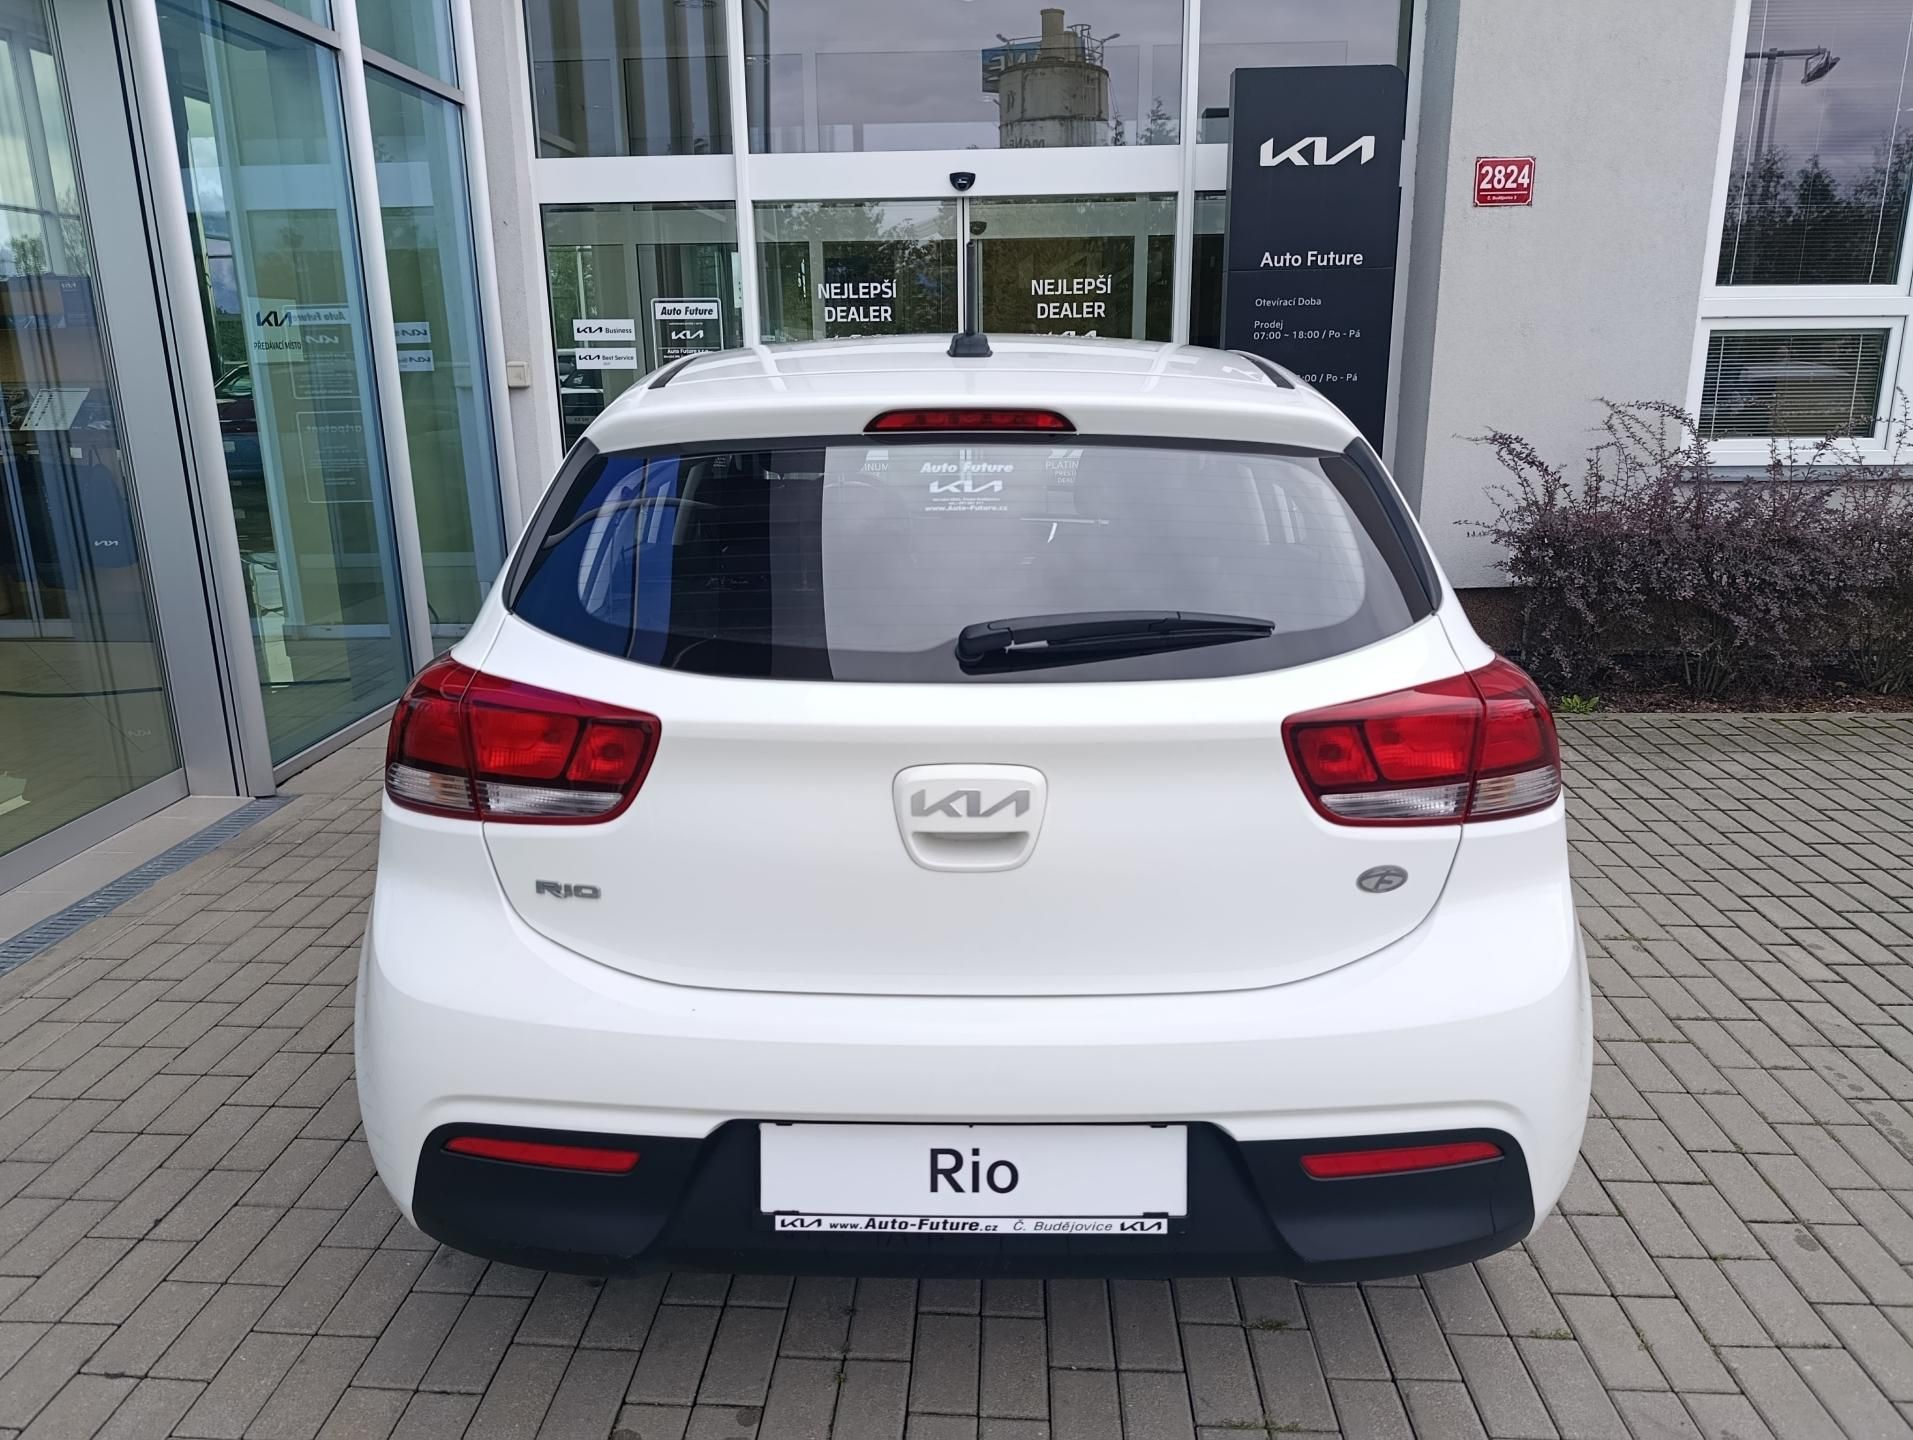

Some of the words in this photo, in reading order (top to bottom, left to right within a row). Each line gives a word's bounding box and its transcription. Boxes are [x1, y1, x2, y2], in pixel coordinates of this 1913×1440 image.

[1259, 135, 1376, 167] KIA
[1480, 165, 1530, 189] 2824
[1260, 252, 1302, 267] Auto
[1307, 251, 1364, 266] Future
[817, 278, 897, 300] NEJLEPŠÍ
[1031, 274, 1112, 296] NEJLEPŠÍ
[1255, 297, 1296, 307] Otevírací
[1298, 297, 1322, 306] Doba
[661, 306, 681, 316] Auto
[685, 306, 714, 316] Future
[824, 306, 892, 323] DEALER
[1037, 302, 1106, 319] DEALER
[256, 311, 293, 327] KIA
[1254, 320, 1284, 331] Prodej
[671, 329, 704, 340] KIA
[1253, 331, 1281, 340] 07:00
[1293, 330, 1320, 339] 18:00
[1328, 331, 1341, 339] Po
[1349, 329, 1361, 338] Pá
[1326, 374, 1338, 382] Po
[1346, 372, 1358, 382] Pá
[920, 462, 958, 473] Auto
[962, 461, 1014, 473] Future
[929, 480, 1003, 493] KIA
[910, 789, 1031, 818] KIA
[535, 879, 602, 899] RIO
[929, 1148, 1019, 1194] Rio
[780, 1218, 823, 1228] KIA
[829, 1218, 999, 1232] www.Auto-Future.cz
[1013, 1219, 1027, 1232] Č.
[1033, 1220, 1113, 1233] Budějovice
[1120, 1220, 1162, 1232] KIA
